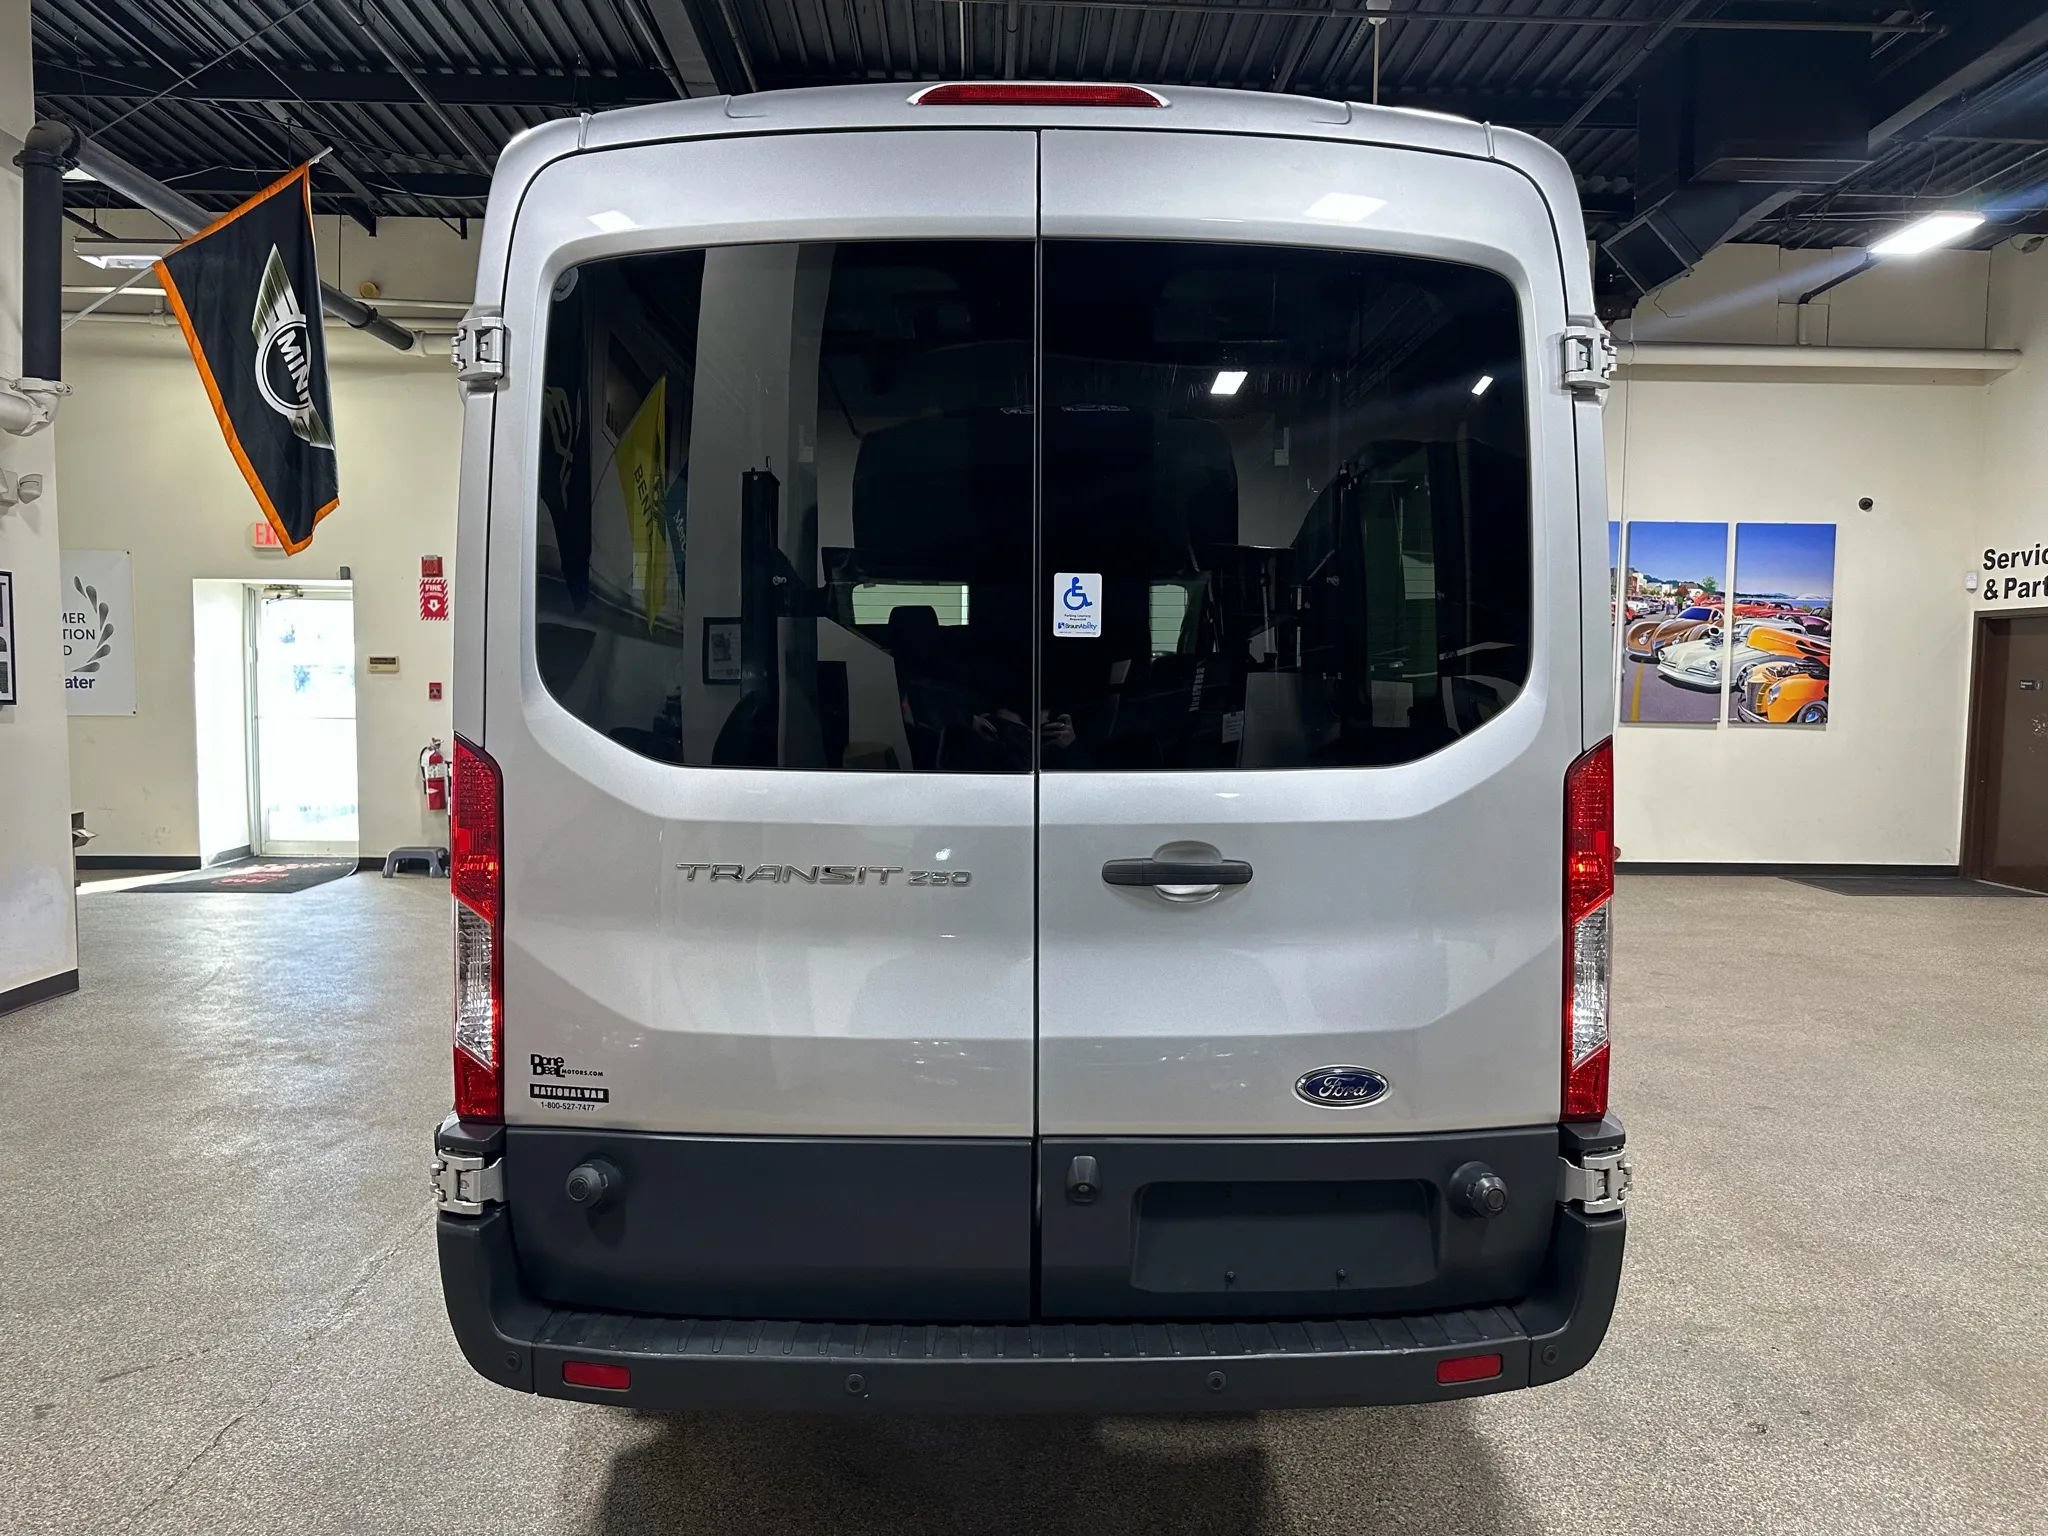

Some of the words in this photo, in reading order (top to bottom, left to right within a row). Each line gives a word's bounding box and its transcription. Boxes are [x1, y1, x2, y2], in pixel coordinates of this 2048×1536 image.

[425, 584, 443, 592] FIRE
[1983, 578, 1999, 600] &
[676, 863, 904, 885] TRANSIT
[907, 870, 973, 887] 250
[530, 1053, 565, 1067] Done
[561, 1069, 604, 1077] MOTORS.COM
[533, 1086, 583, 1098] NATIONAL
[583, 1089, 604, 1099] VAN
[1318, 1076, 1369, 1097] Ford
[540, 1101, 596, 1111] 1-800-527-7477
